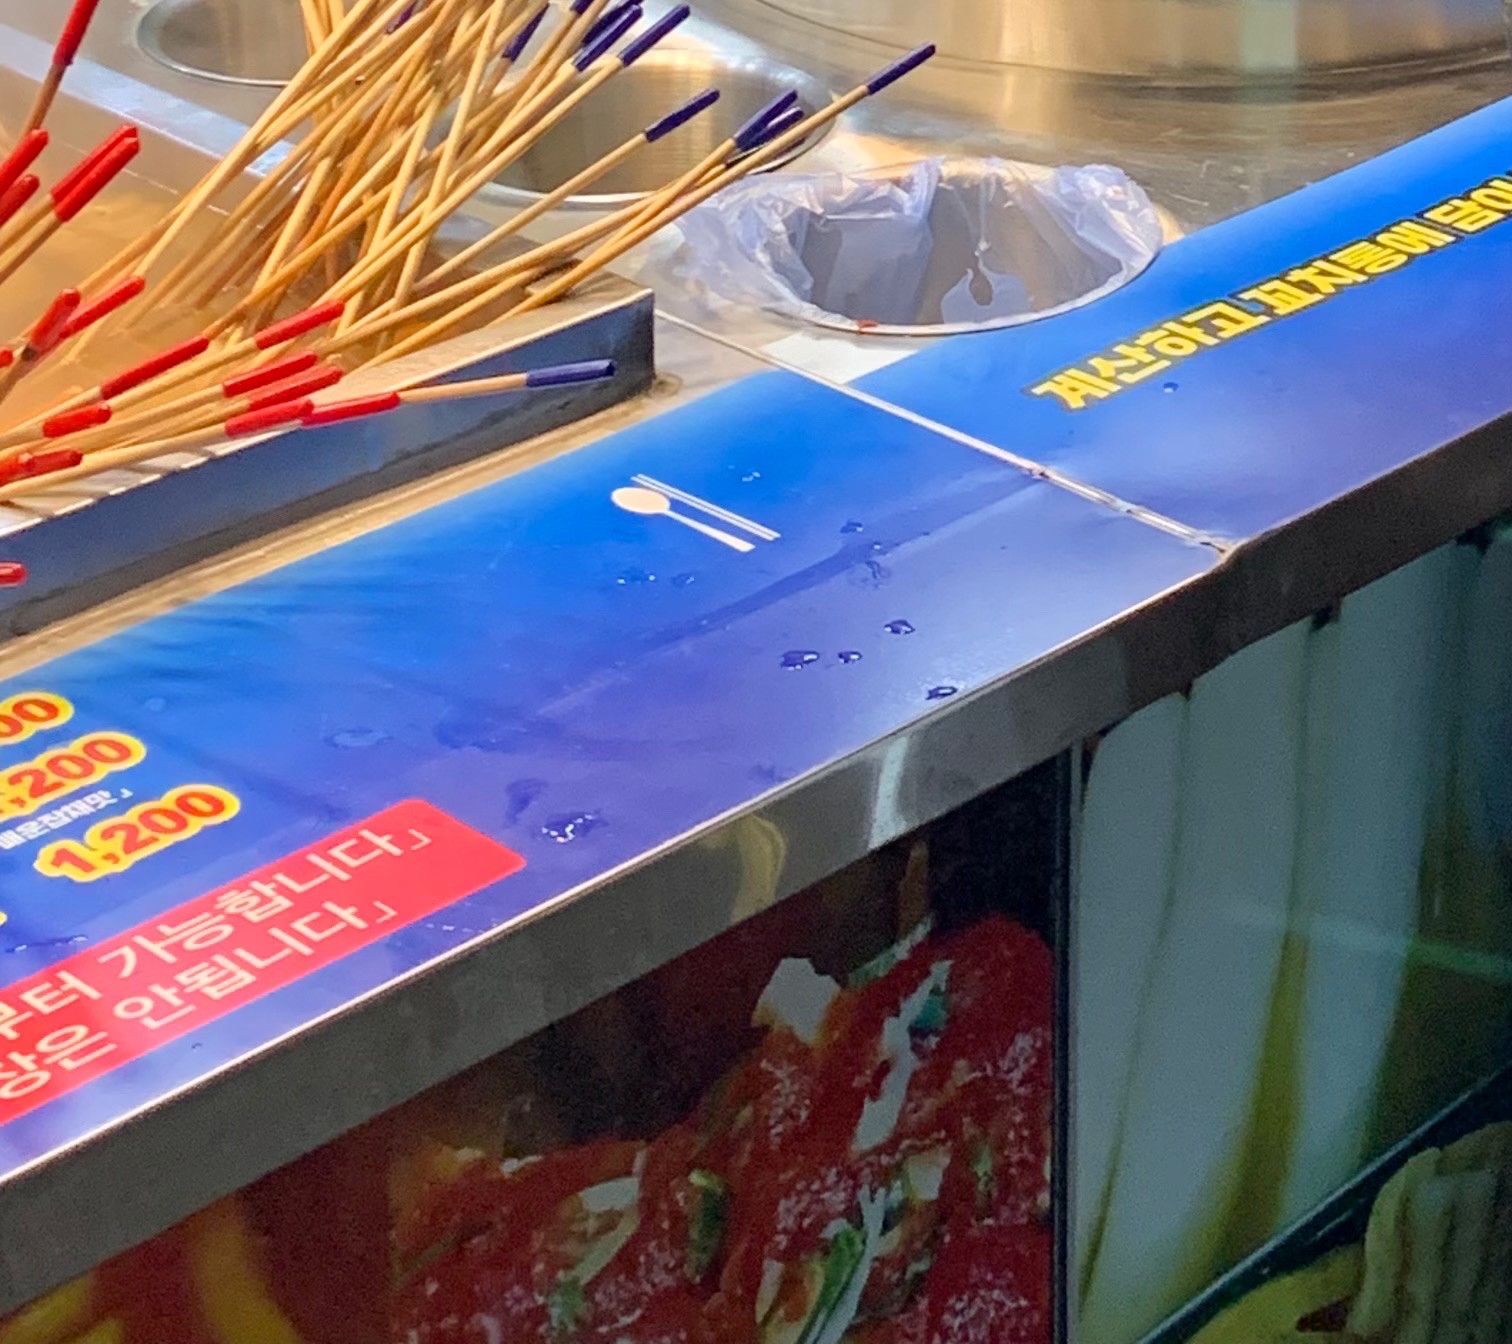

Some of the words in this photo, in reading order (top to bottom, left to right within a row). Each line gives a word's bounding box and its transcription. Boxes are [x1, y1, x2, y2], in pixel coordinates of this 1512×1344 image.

[1031, 300, 1272, 410] 계산하고
[1239, 220, 1457, 316] 꼬치통에
[50, 791, 226, 874] 1,200
